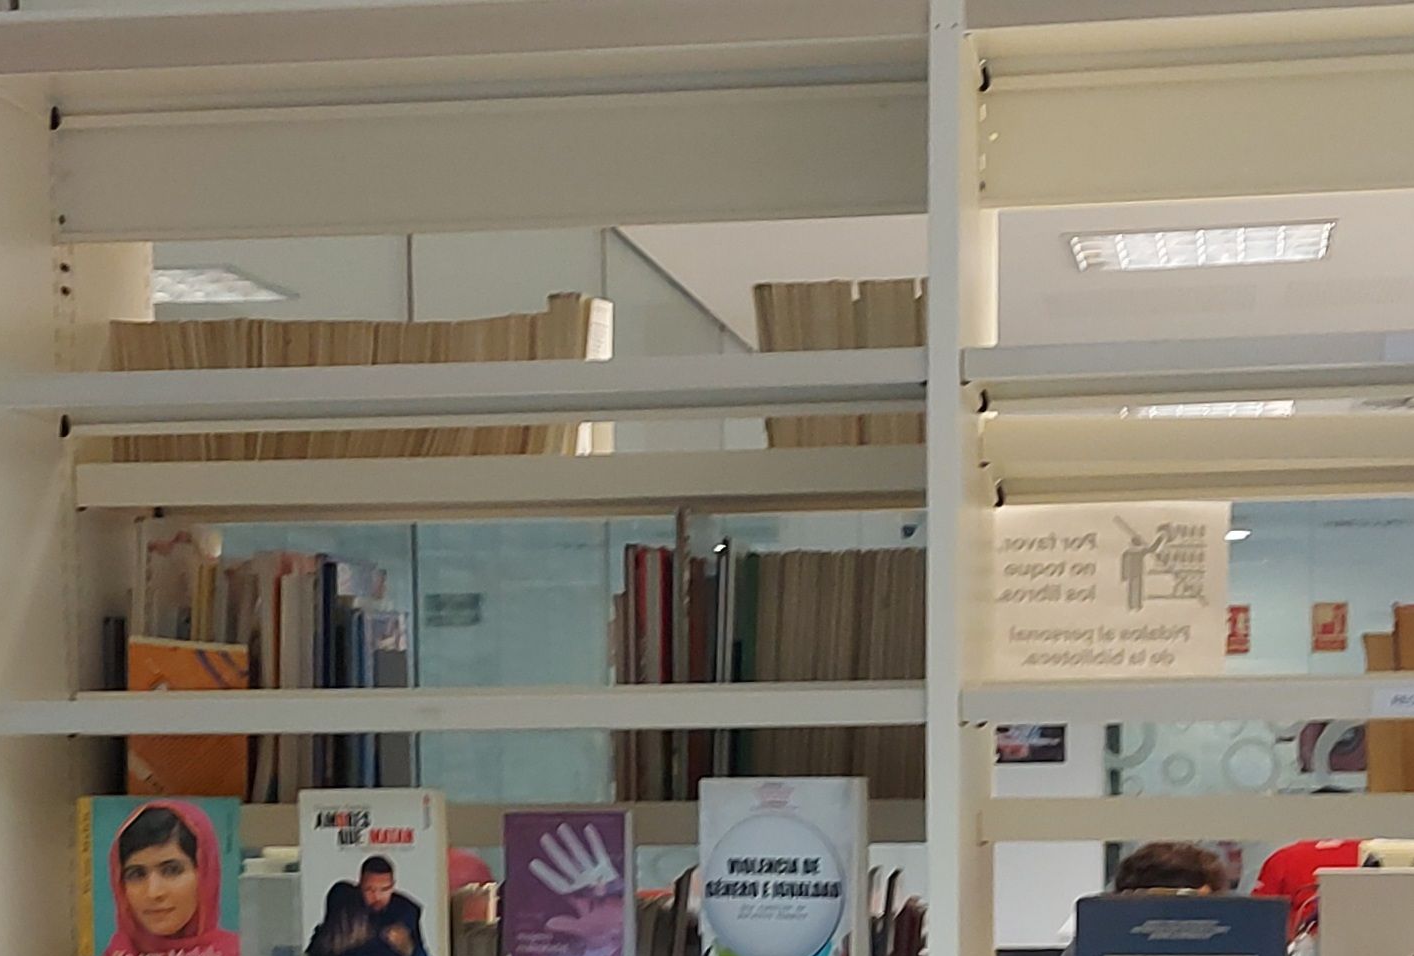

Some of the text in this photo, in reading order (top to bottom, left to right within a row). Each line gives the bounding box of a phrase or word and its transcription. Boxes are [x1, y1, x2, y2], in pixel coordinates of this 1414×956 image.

[727, 857, 822, 874] VIOLENCIA DE
[705, 878, 843, 898] GÉNERO E IGUALDAD
